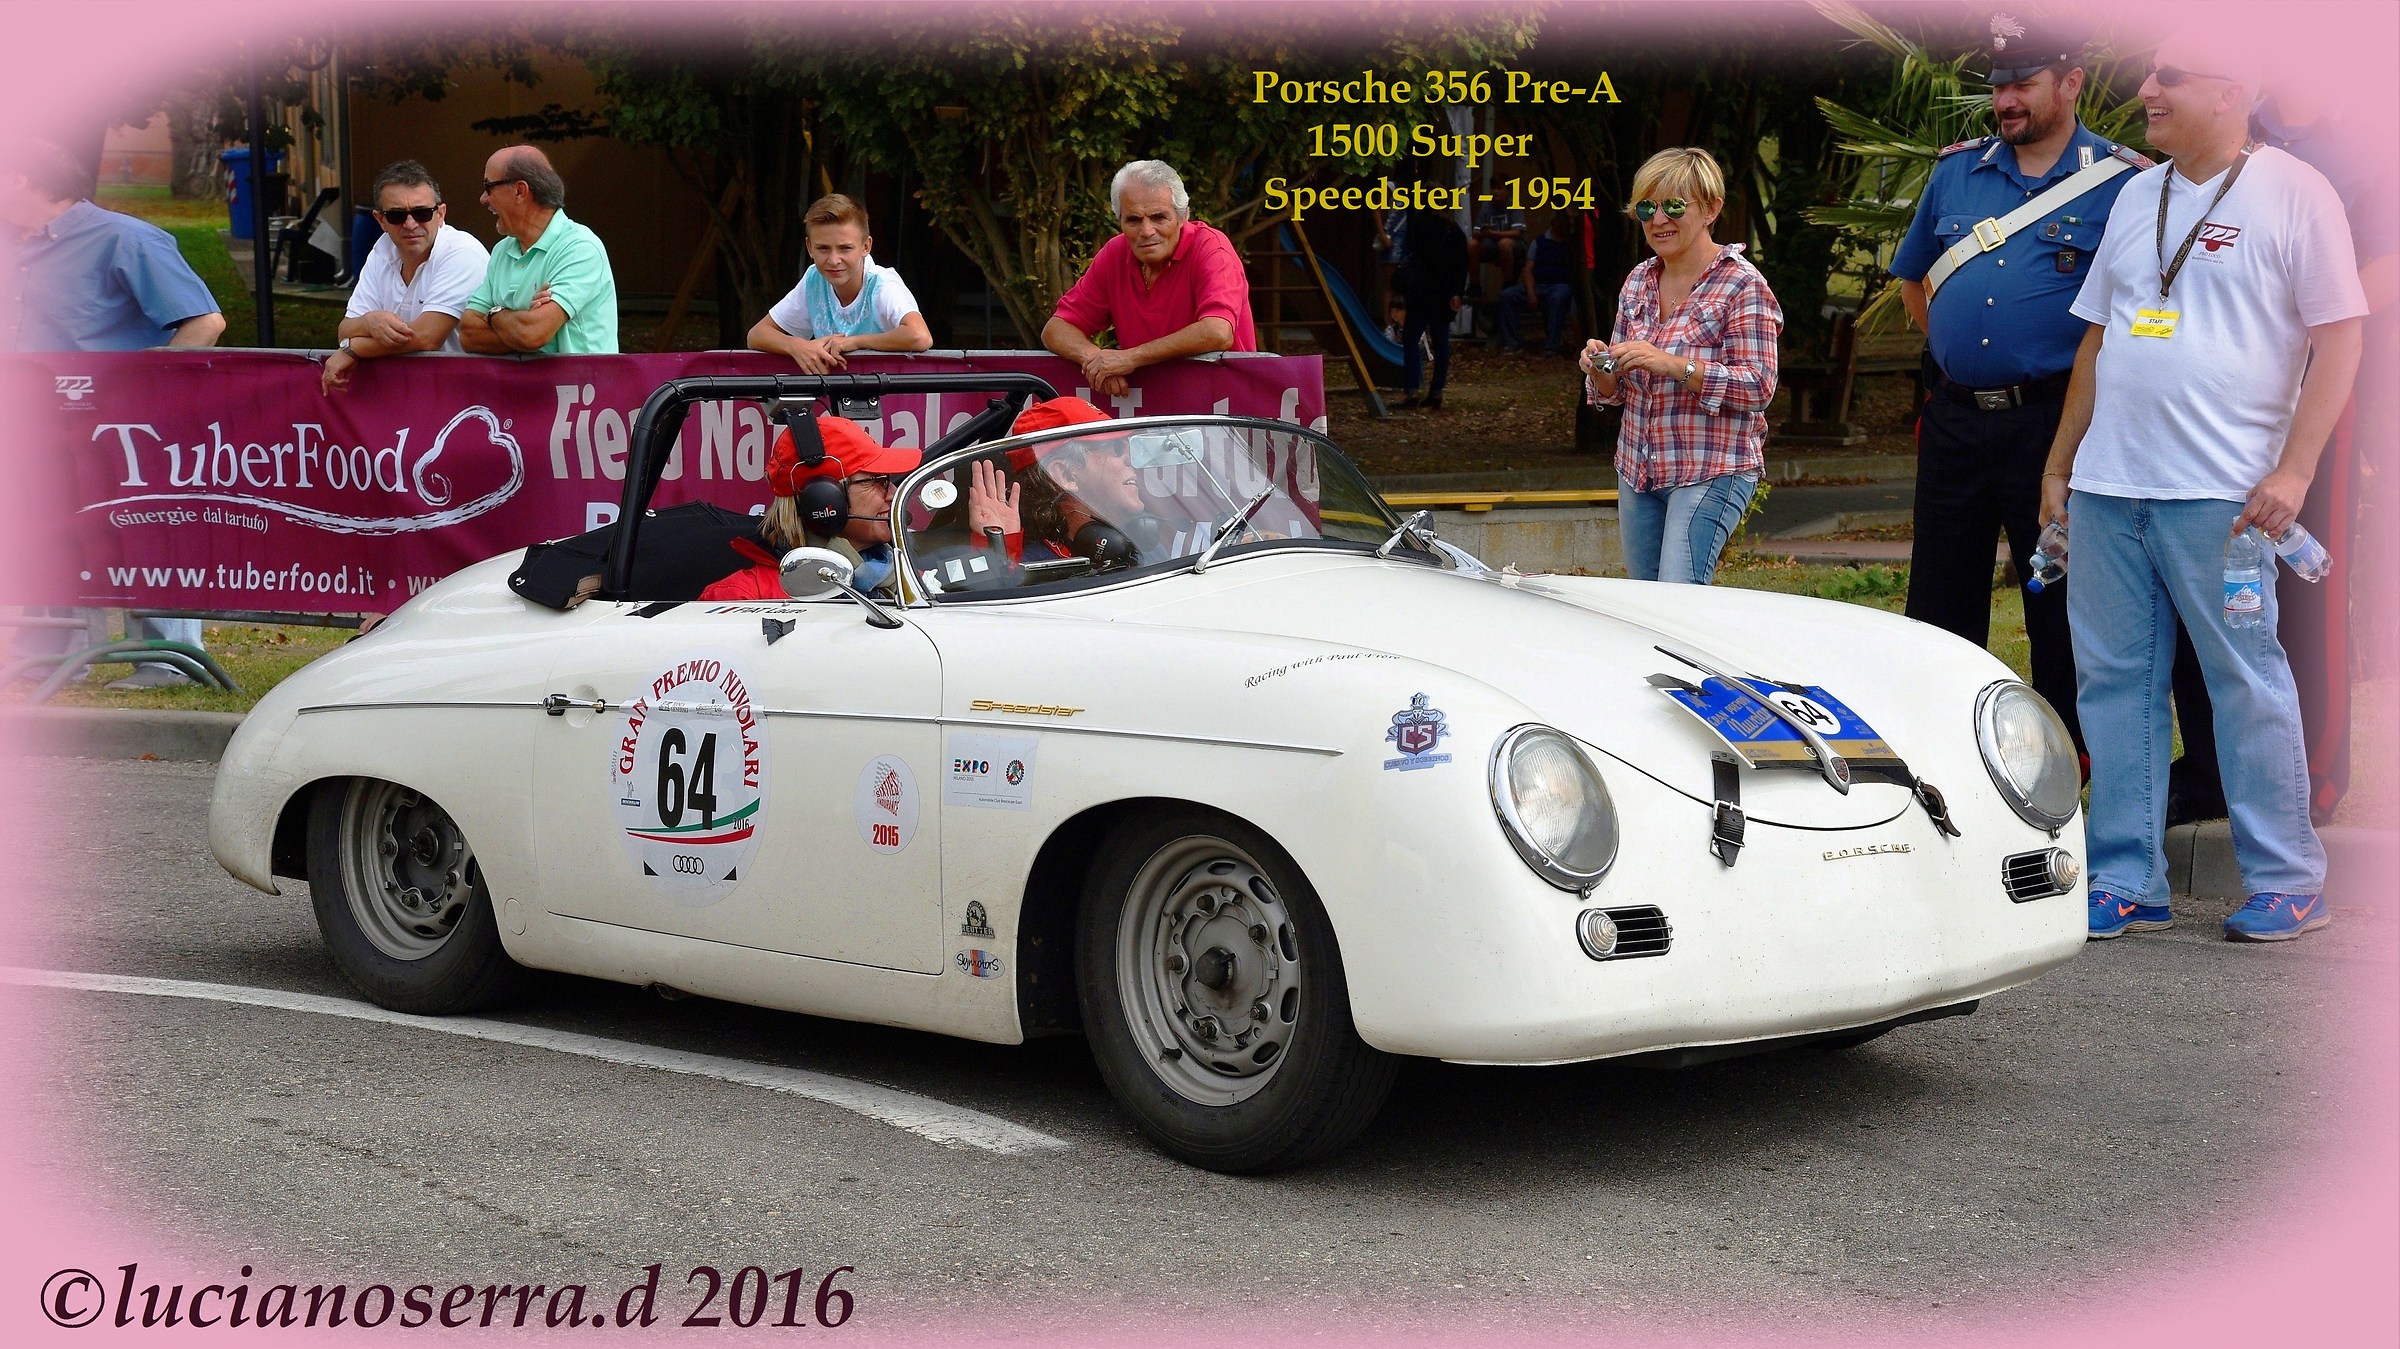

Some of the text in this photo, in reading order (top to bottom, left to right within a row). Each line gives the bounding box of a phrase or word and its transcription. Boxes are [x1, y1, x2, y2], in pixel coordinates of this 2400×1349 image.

[91, 421, 410, 493] TuberFood
[109, 507, 269, 534] (sinergie dal tartufo)
[812, 508, 838, 519] Stilo
[107, 561, 375, 596] www.tuberfood.it
[1245, 666, 1287, 688] Racing
[1291, 655, 1323, 669] with
[1327, 653, 1363, 661] Paul
[970, 700, 1085, 717] Speedster
[1707, 696, 1750, 726] GRAN PREMIO
[1781, 700, 1834, 726] 64
[619, 696, 649, 775] GRAN
[652, 659, 721, 701] PREMIO
[719, 668, 760, 789] NUVOLARI
[657, 728, 717, 830] 64
[954, 759, 989, 774] EXPO
[733, 817, 750, 831] 2016
[873, 824, 899, 847] 2015
[1823, 843, 1911, 860] PORSCHE
[962, 925, 993, 935] REUTTER
